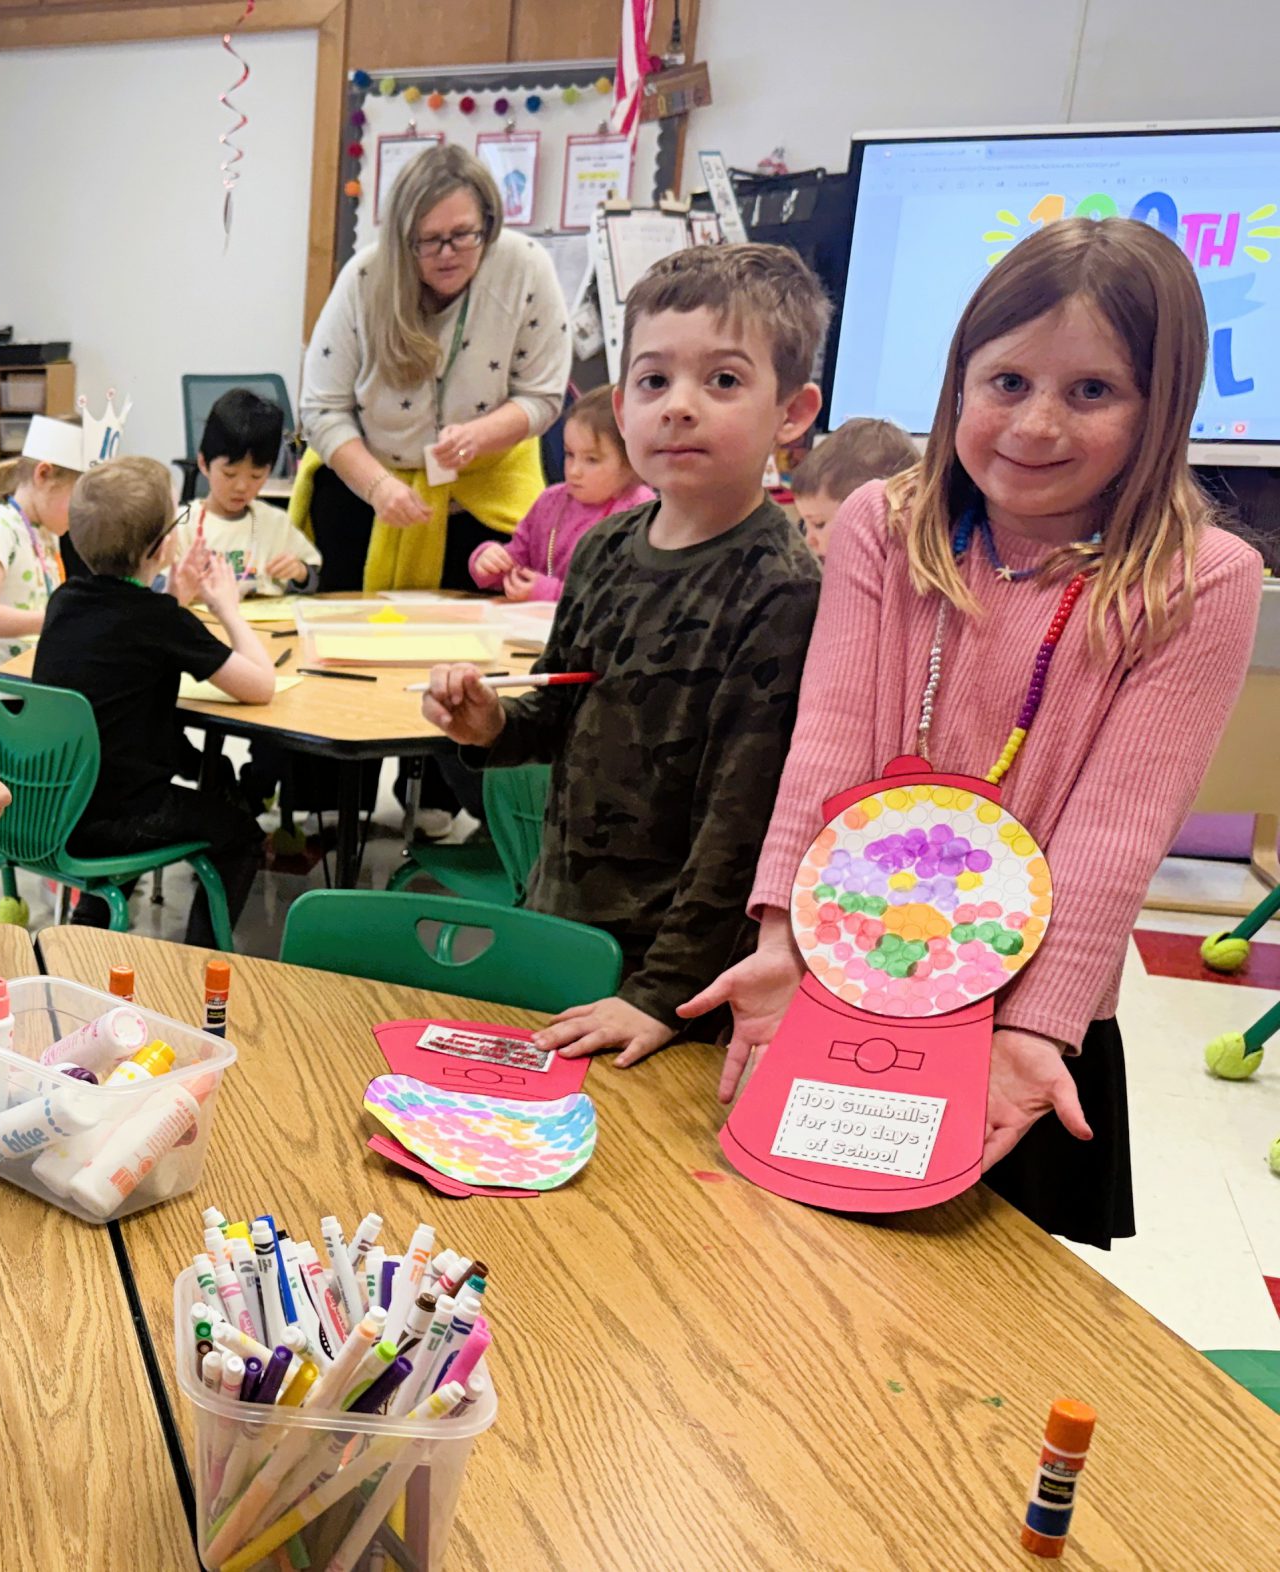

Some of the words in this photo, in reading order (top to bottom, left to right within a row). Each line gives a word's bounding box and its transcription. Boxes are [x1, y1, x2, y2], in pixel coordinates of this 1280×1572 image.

[800, 1092, 835, 1110] 100
[839, 1097, 930, 1123] Gumballs
[1, 1127, 49, 1153] blue
[796, 1113, 826, 1130] for
[831, 1120, 867, 1137] 100
[870, 1125, 920, 1146] days
[806, 1138, 827, 1151] of
[831, 1140, 898, 1164] School
